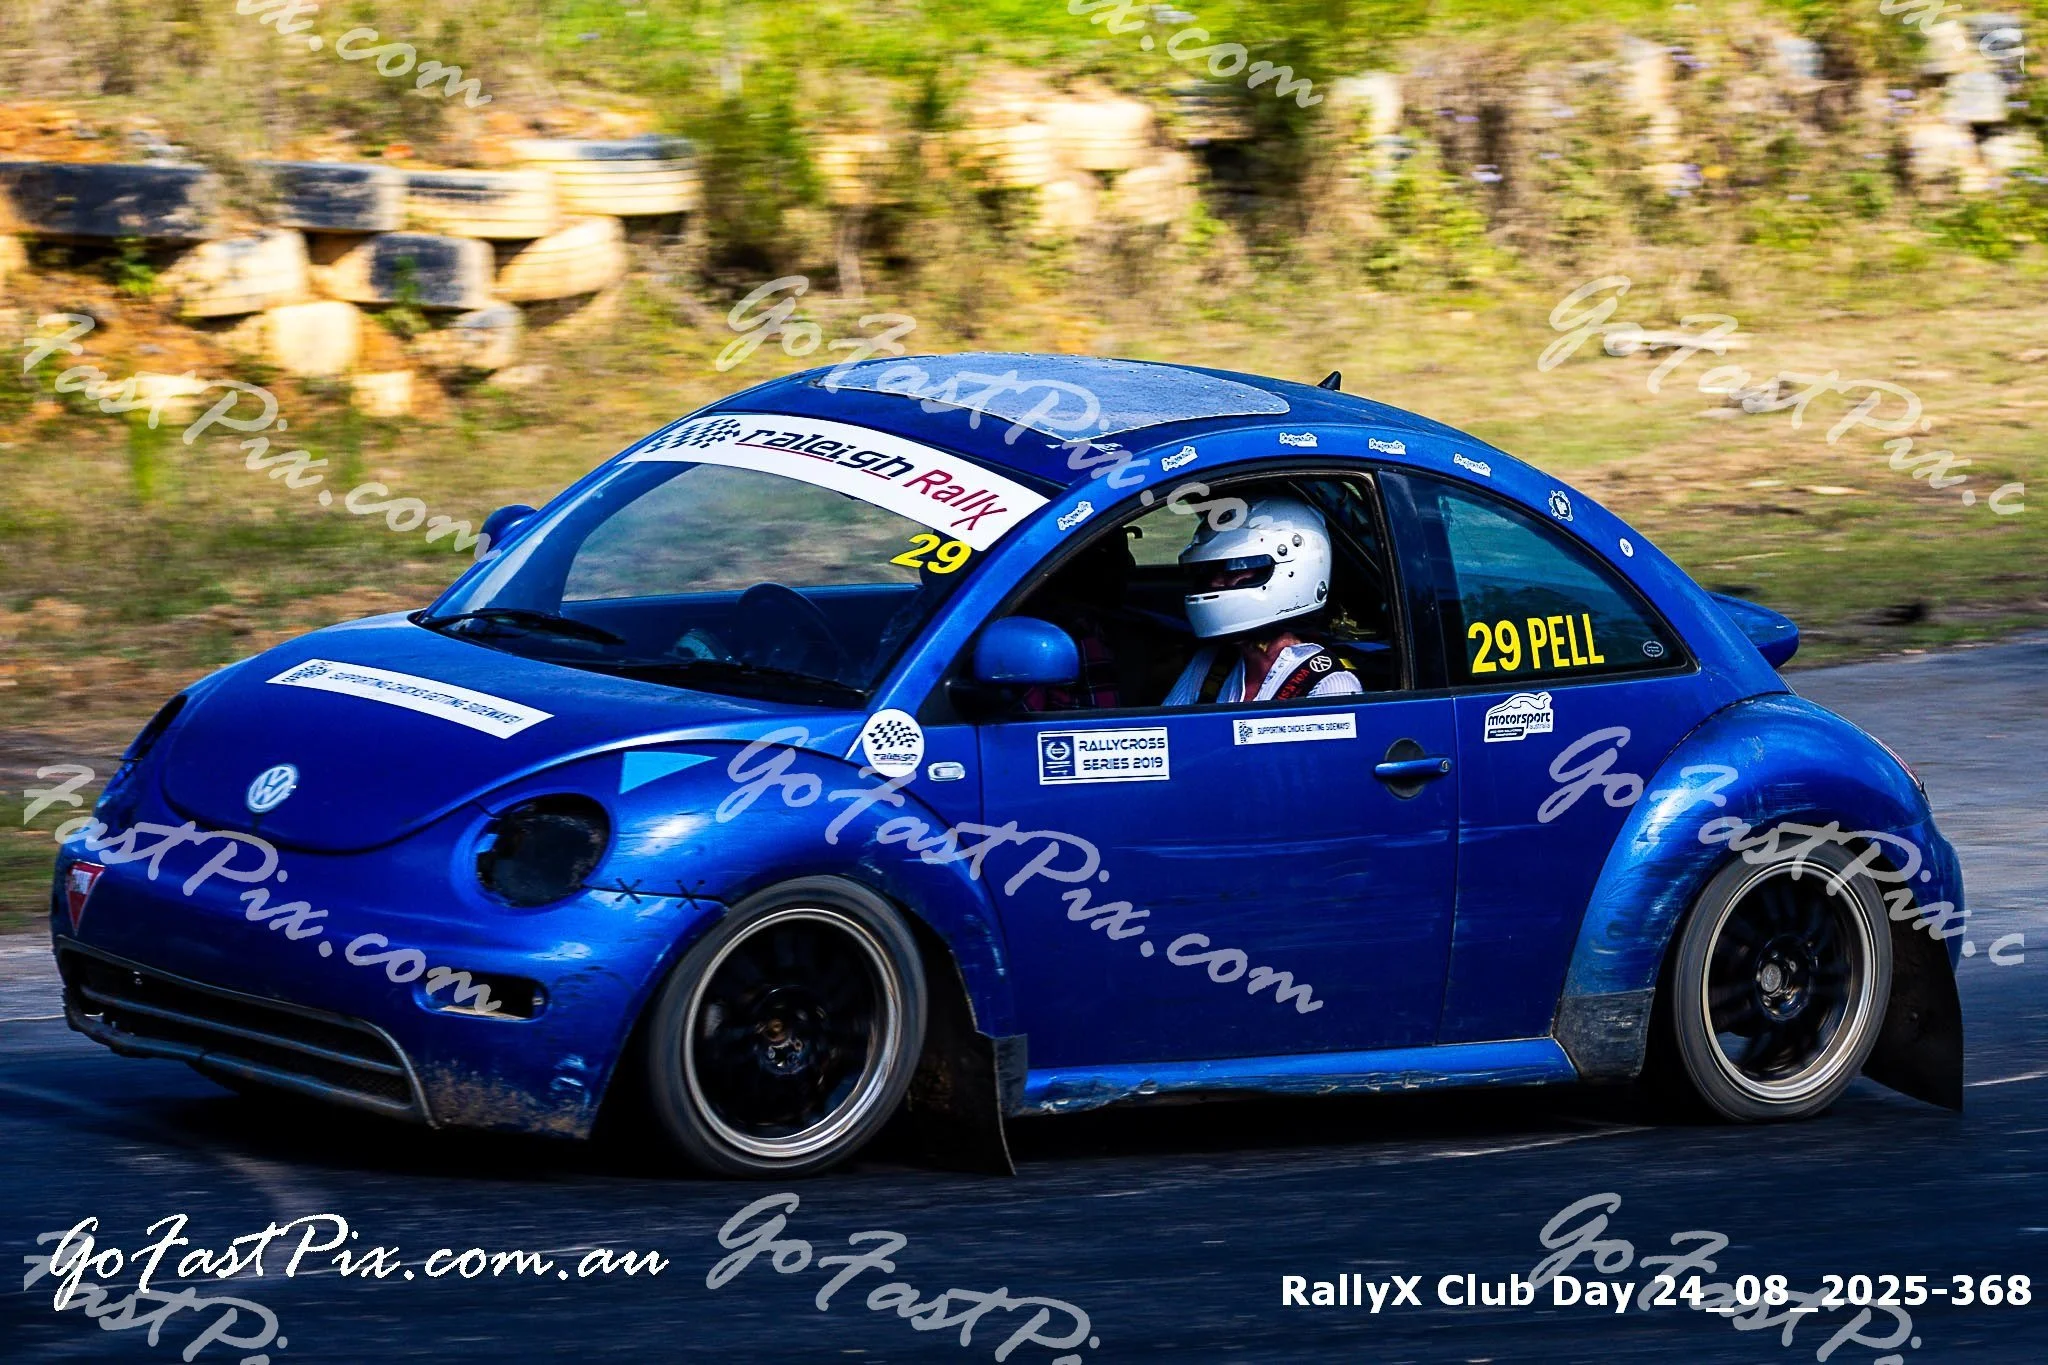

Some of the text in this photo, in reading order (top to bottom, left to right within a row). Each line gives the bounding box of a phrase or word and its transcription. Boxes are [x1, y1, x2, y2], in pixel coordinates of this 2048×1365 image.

[739, 428, 915, 478] raleigh
[891, 533, 972, 574] 29
[1468, 613, 1605, 673] 29 PELL
[1488, 712, 1551, 729] motorsport
[1079, 738, 1166, 752] RALLYCROSS
[1083, 757, 1130, 771] SERIES
[1133, 756, 1163, 769] 2019
